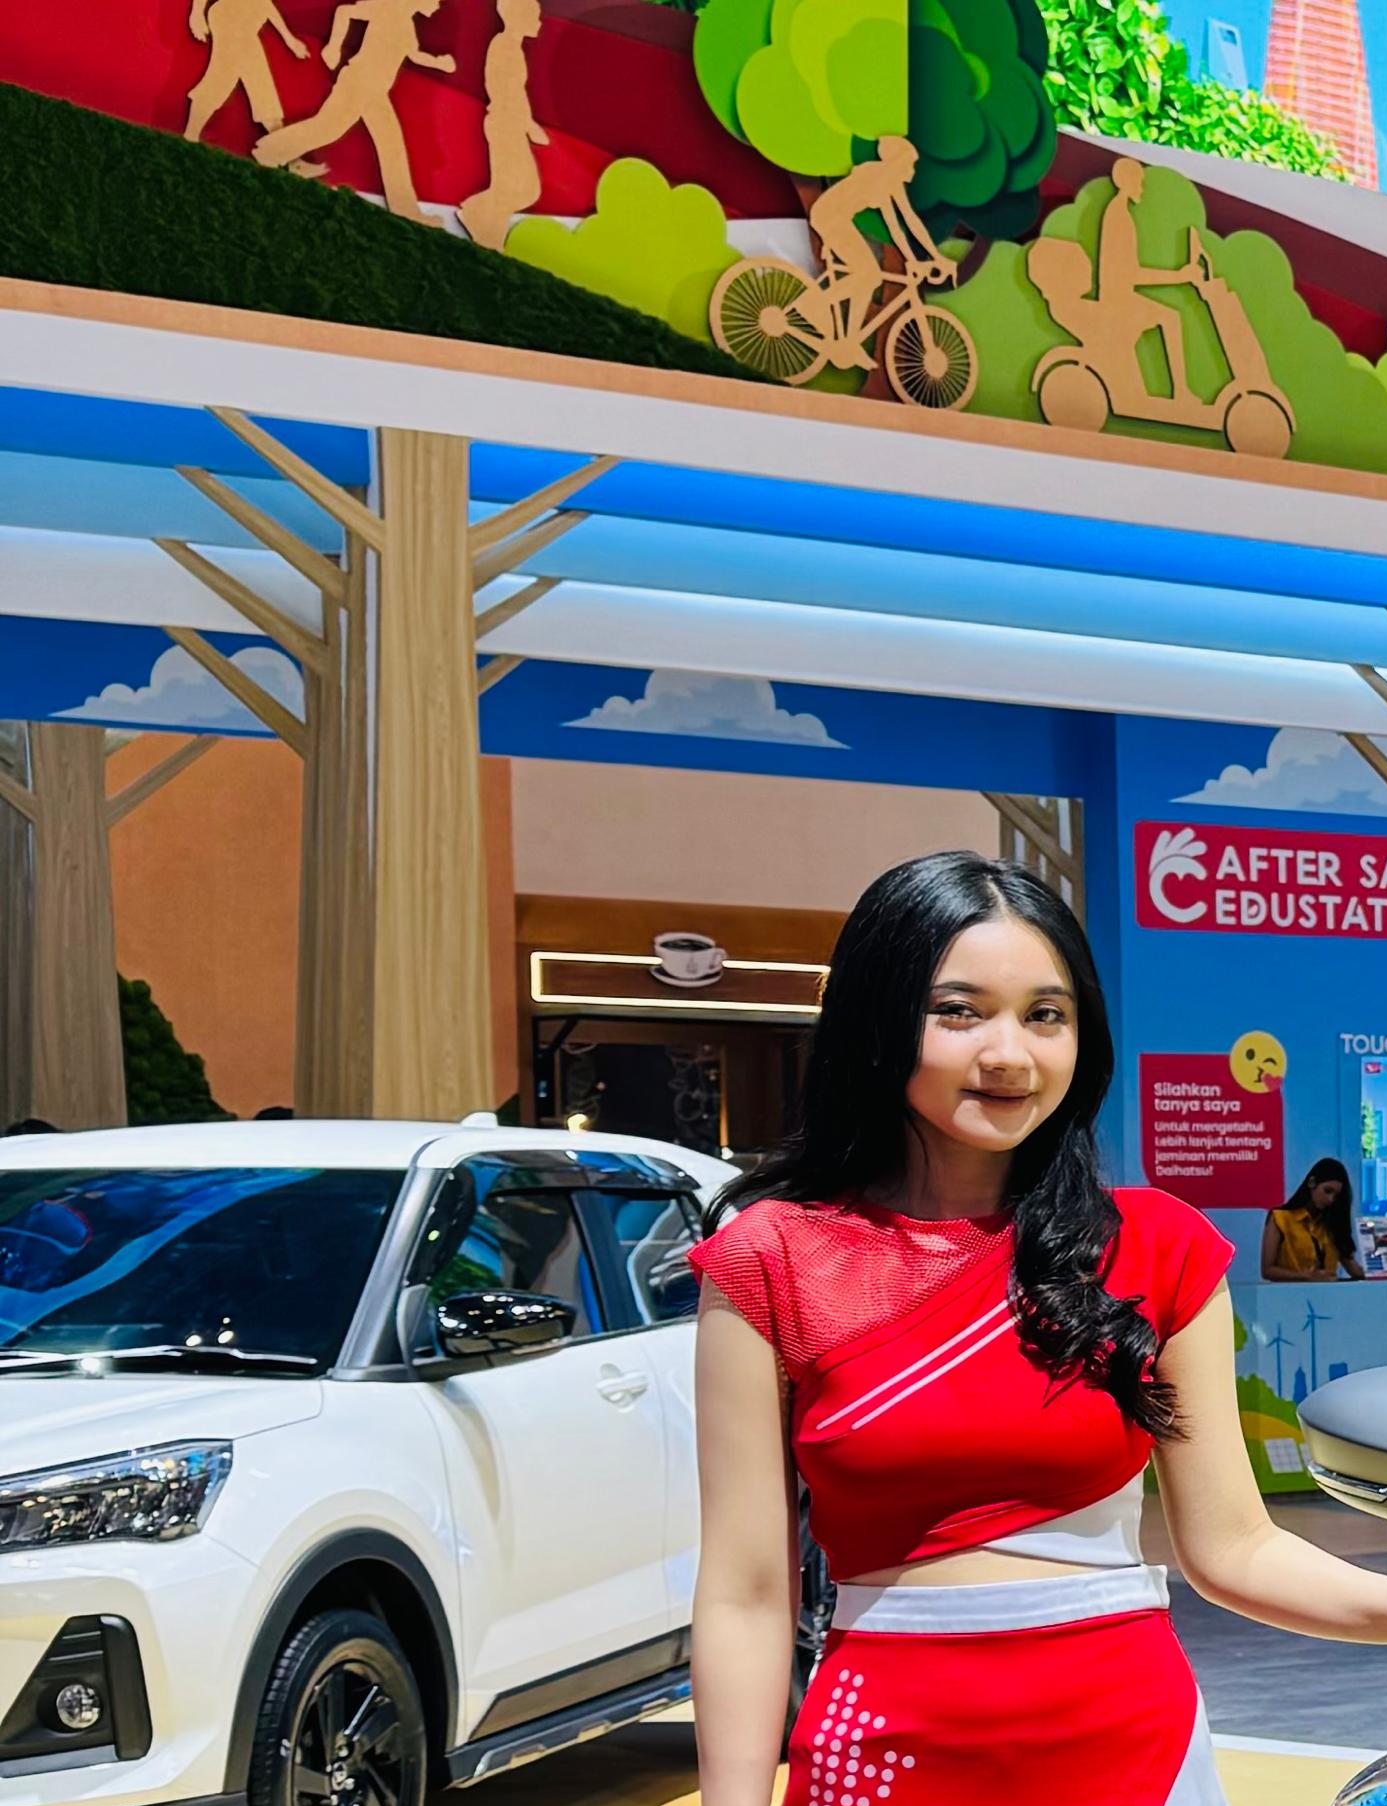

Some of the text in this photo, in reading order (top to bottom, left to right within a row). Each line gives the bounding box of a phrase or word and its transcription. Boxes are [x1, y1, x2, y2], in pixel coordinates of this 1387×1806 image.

[1215, 846, 1343, 887] AFTER
[1153, 1082, 1221, 1097] Silahkan
[1154, 1098, 1241, 1115] tanya saya
[1154, 1121, 1264, 1135] Untuk mengetahui
[1225, 1137, 1272, 1150] tentang
[1155, 1151, 1258, 1164] jaminan memiliki
